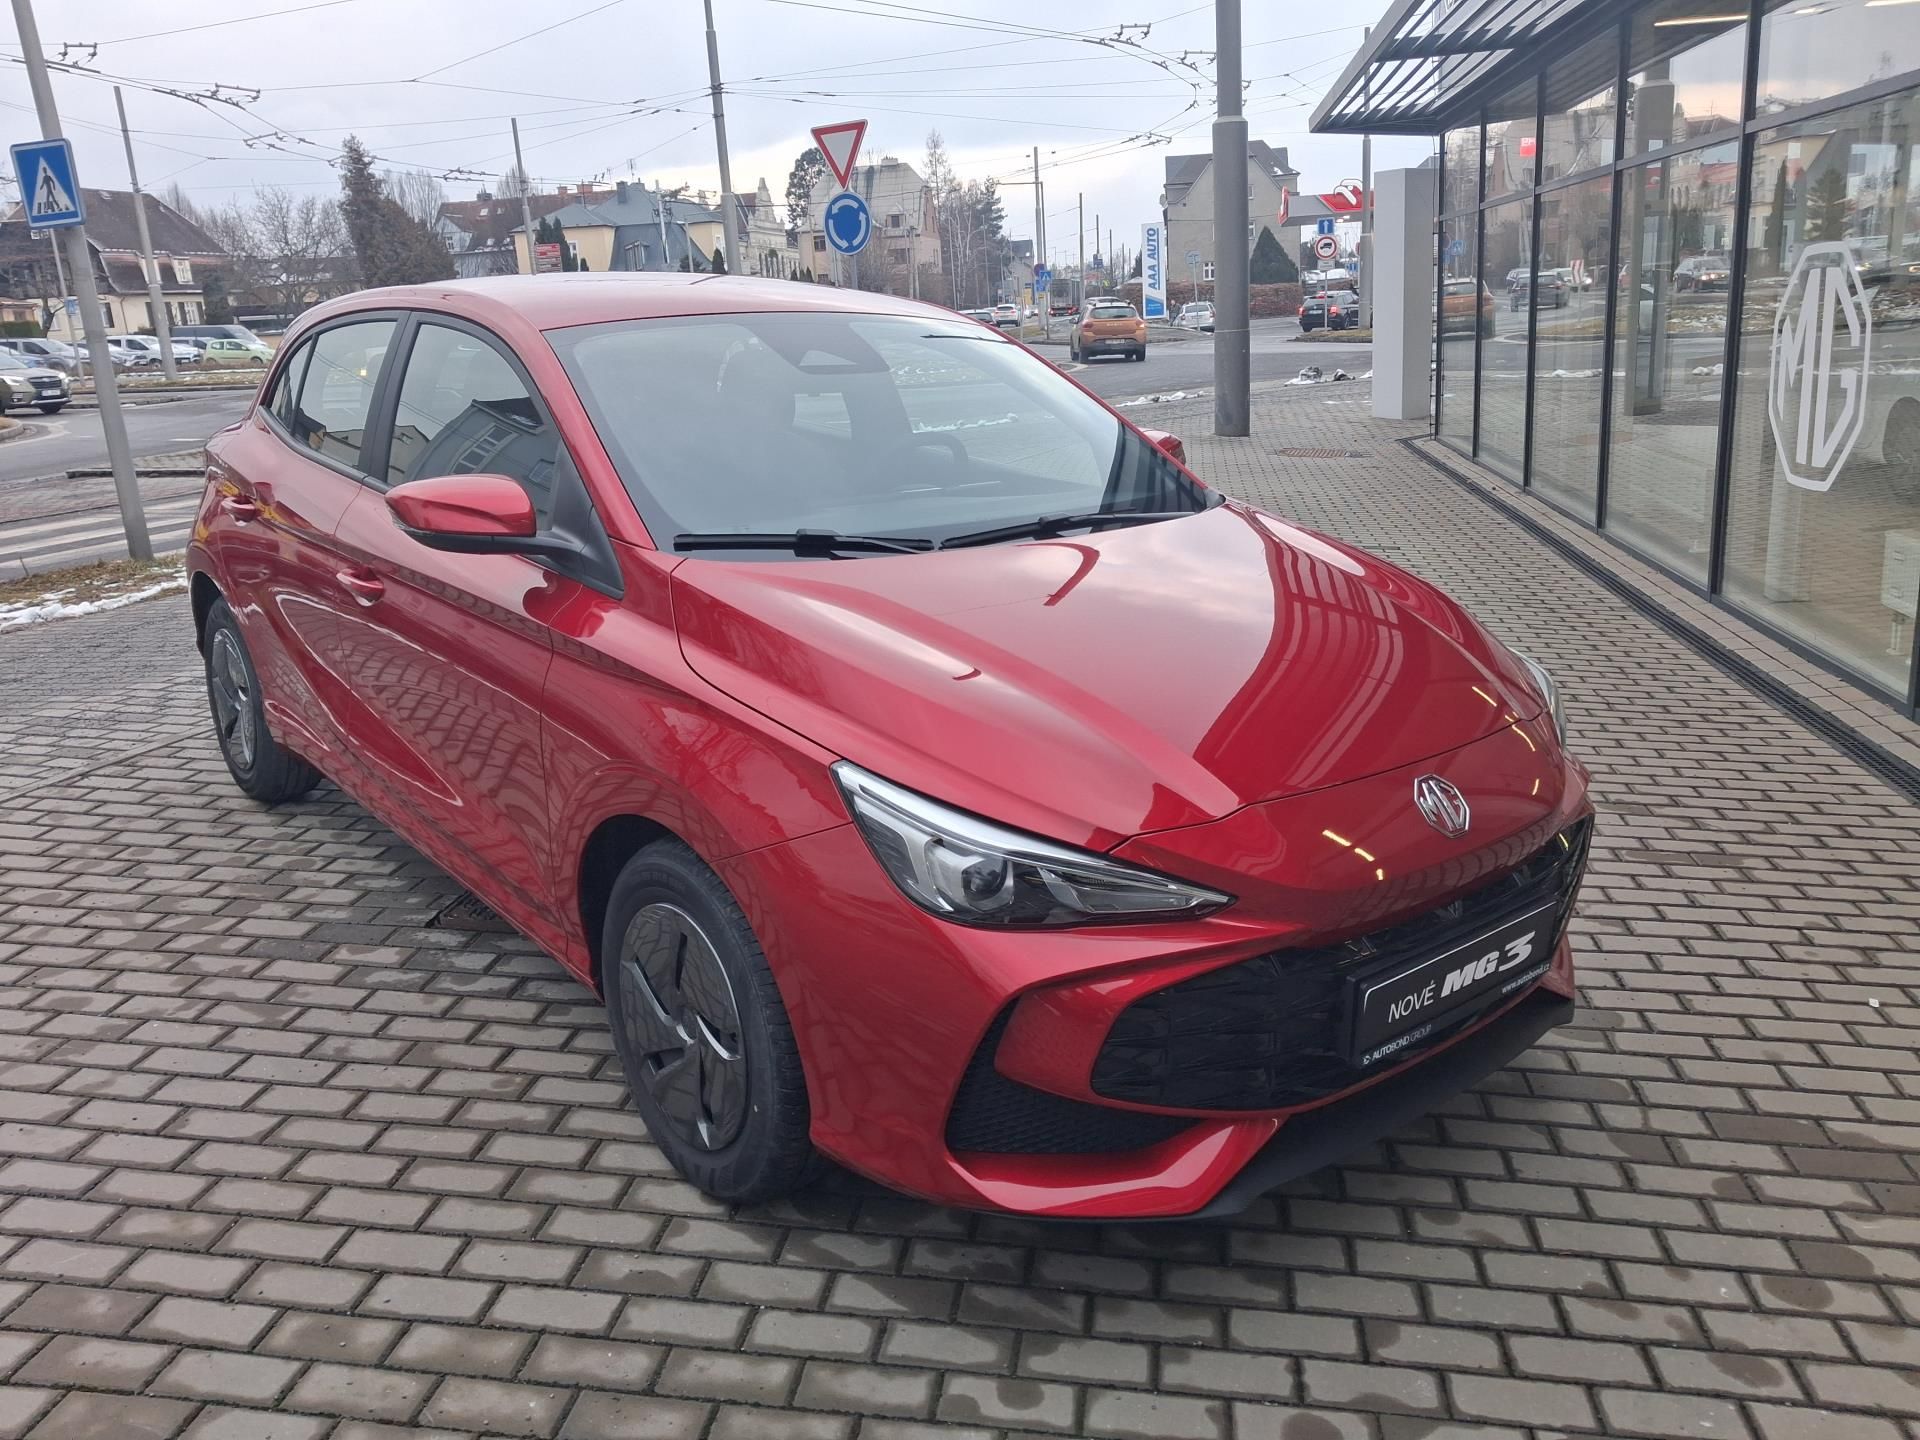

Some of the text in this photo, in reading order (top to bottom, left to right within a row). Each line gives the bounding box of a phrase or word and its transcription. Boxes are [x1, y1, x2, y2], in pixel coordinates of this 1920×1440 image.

[1146, 227, 1157, 261] AUTO
[1147, 263, 1158, 291] AAA
[1776, 266, 1861, 468] MG
[1419, 779, 1465, 831] MG
[1388, 979, 1436, 1023] NOVÉ
[1372, 1035, 1410, 1061] AUTOBOND
